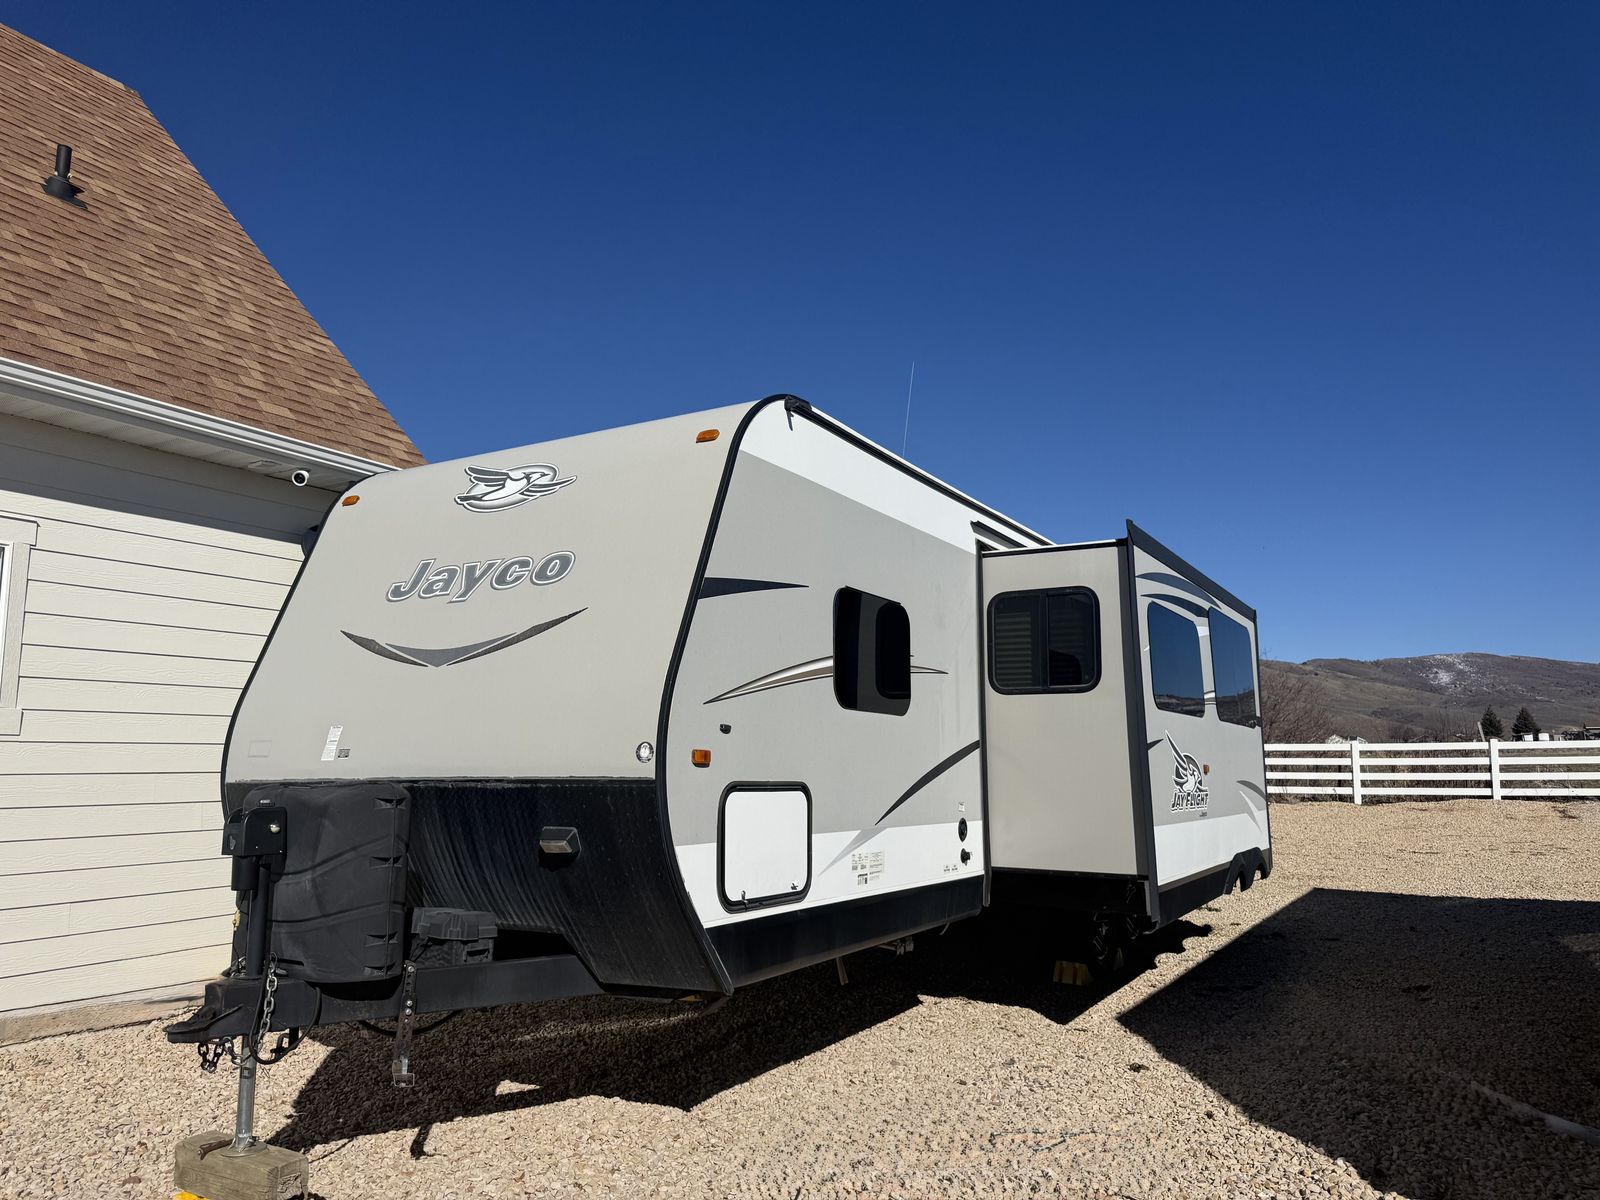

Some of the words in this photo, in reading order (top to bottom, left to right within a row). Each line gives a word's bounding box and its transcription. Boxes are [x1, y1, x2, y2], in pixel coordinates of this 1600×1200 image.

[386, 551, 576, 604] Jayco
[1171, 791, 1186, 809] JAY
[1185, 791, 1208, 808] FLIGHT
